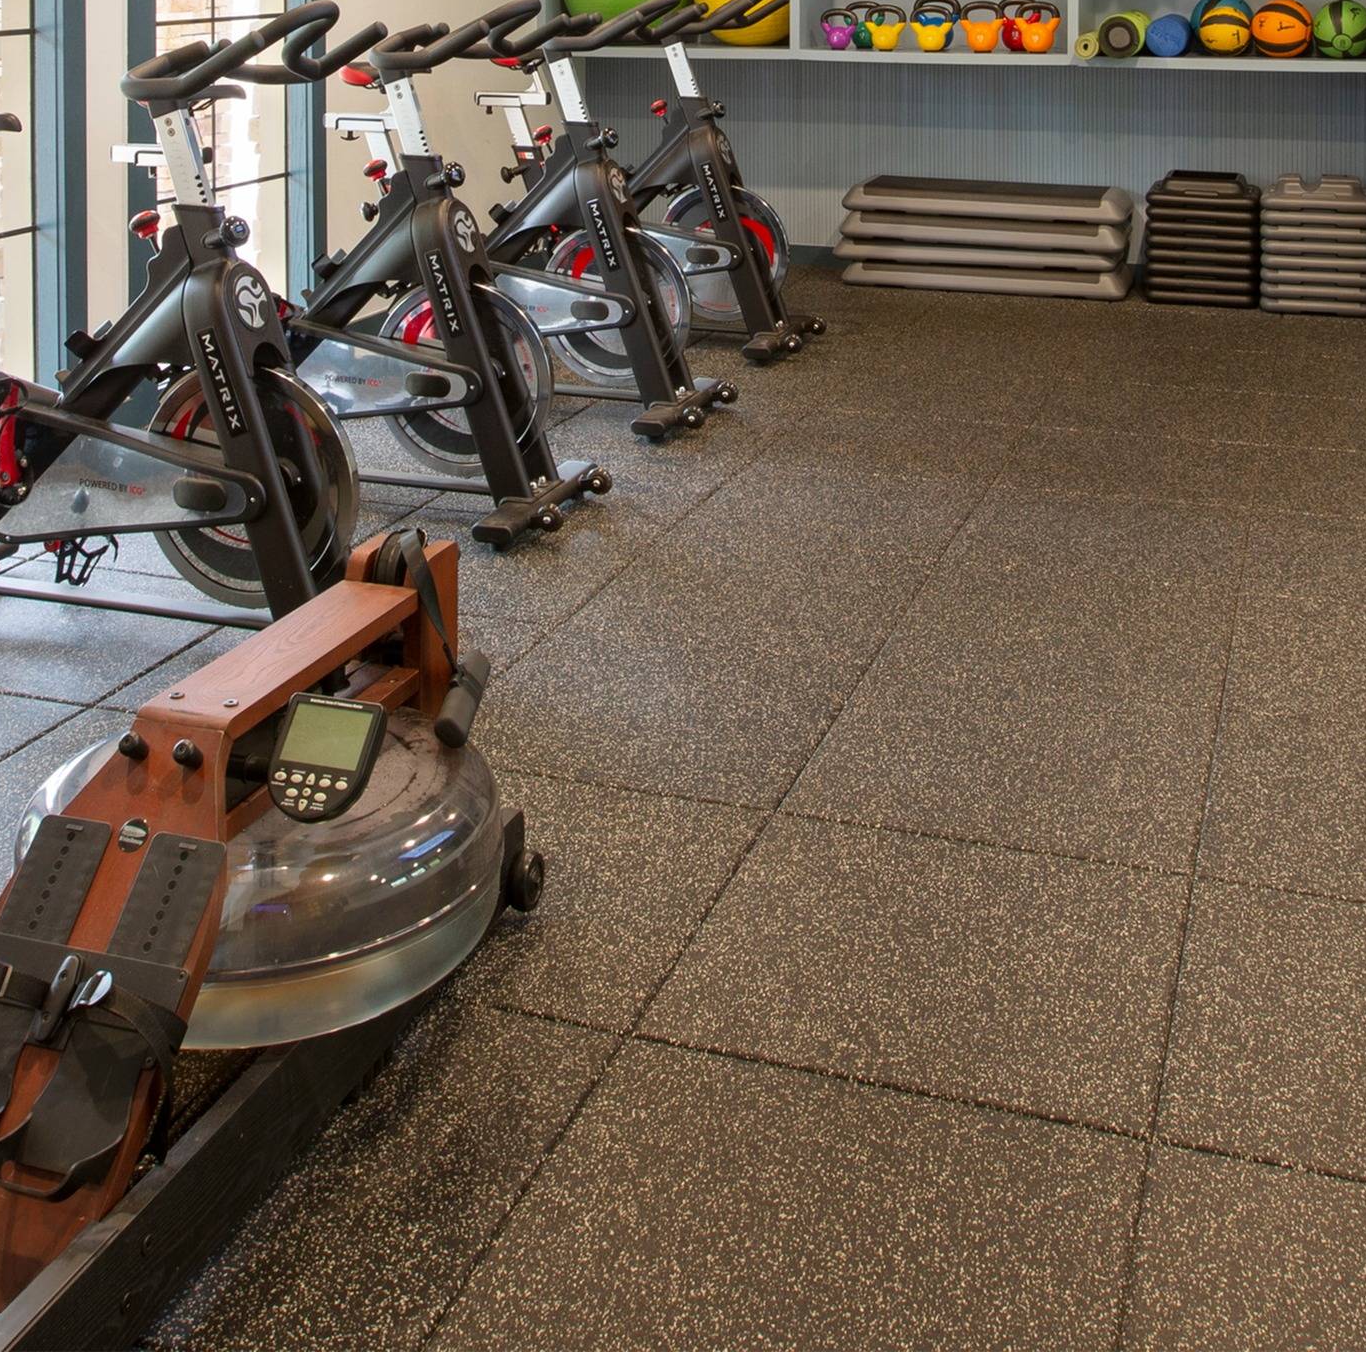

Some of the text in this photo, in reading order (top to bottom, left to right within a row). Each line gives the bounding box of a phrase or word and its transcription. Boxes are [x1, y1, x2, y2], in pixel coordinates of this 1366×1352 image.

[702, 164, 725, 218] MATRIX
[590, 203, 617, 267] MATRIX
[429, 254, 460, 332] MATRIX
[201, 333, 241, 429] MATRIX
[79, 478, 118, 491] POWERED
[119, 483, 128, 493] BY
